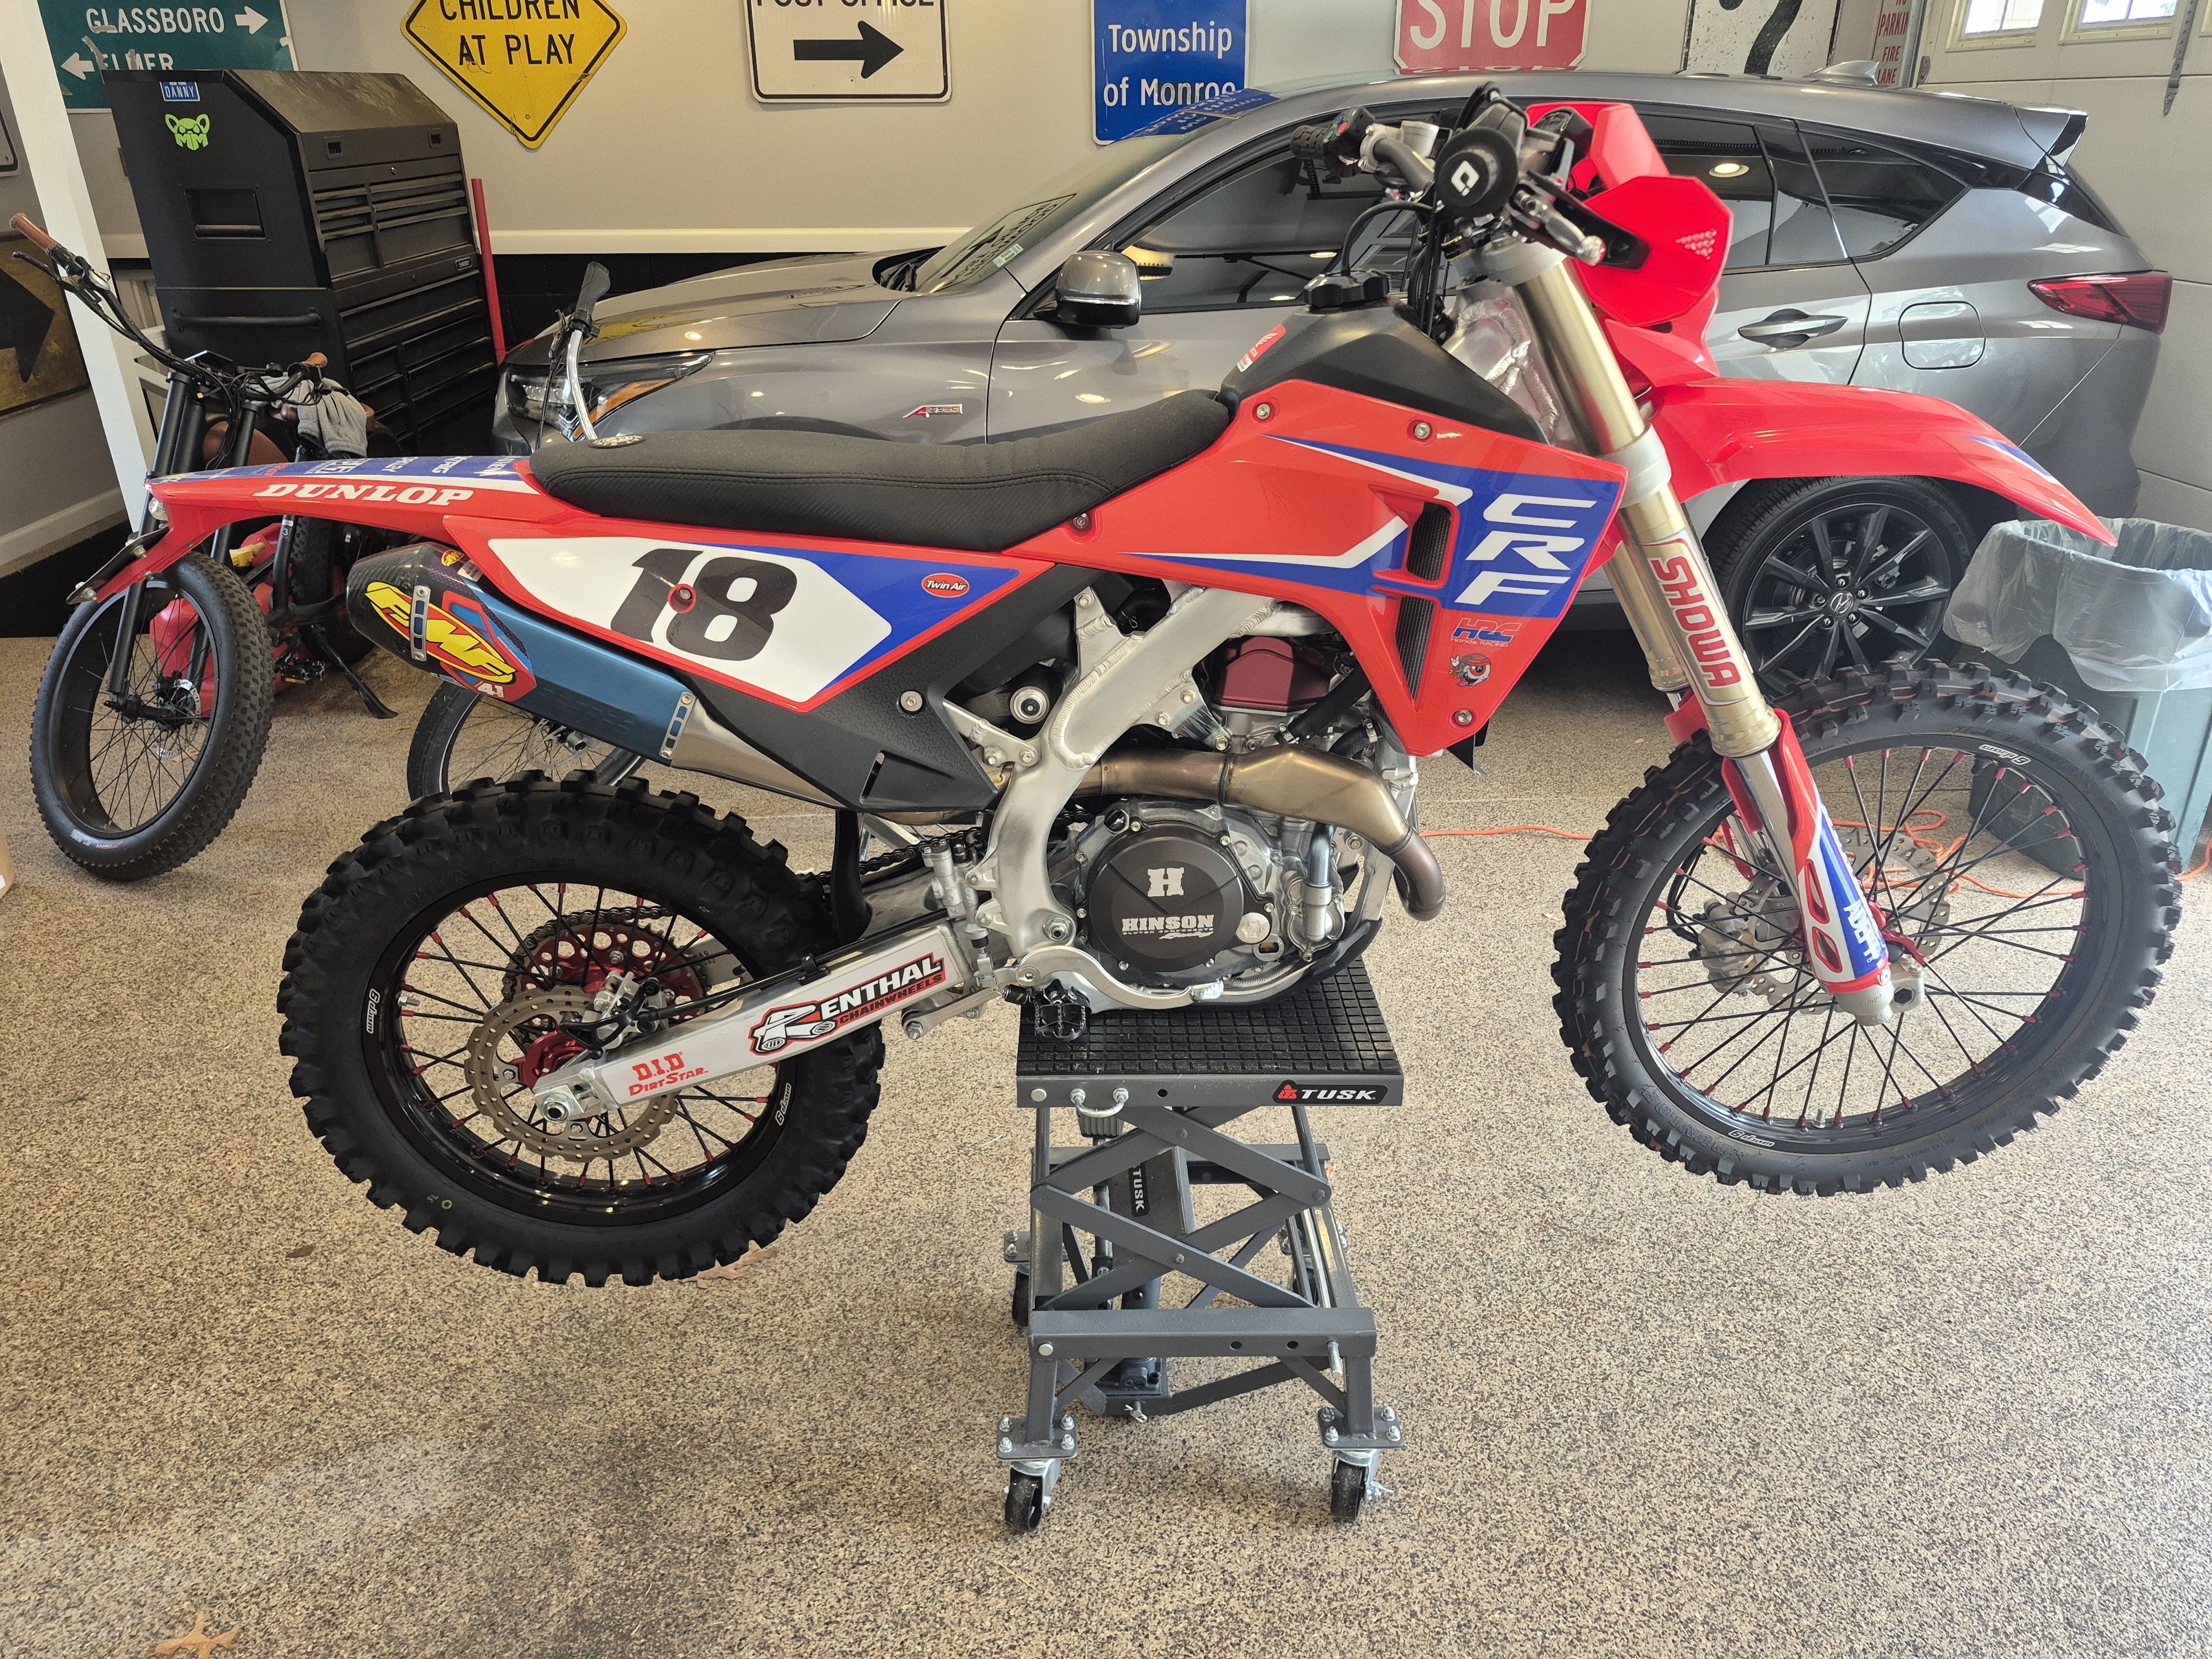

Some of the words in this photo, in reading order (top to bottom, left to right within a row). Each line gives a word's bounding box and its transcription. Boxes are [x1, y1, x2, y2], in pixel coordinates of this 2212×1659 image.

[86, 8, 225, 33] GLASSBORO
[442, 0, 580, 21] CHILDREN
[1879, 12, 1910, 36] PARKIN
[1410, 0, 1585, 50] STOP
[459, 35, 486, 66] AT
[507, 34, 575, 65] PLAY
[1108, 20, 1232, 59] Township
[1882, 46, 1901, 62] FIRE
[1877, 68, 1898, 84] LANE
[164, 86, 194, 98] DANNY
[1103, 76, 1129, 106] of
[252, 483, 474, 506] DUNLOP
[1453, 493, 1597, 606] CRF
[926, 579, 951, 589] Twin
[950, 582, 967, 591] Air
[611, 547, 798, 662] 18
[1452, 618, 1522, 643] HRC
[1651, 555, 1742, 688] SHOWA
[1147, 867, 1185, 897] H
[1121, 915, 1214, 932] HINSON
[753, 958, 942, 1052] RENTHAL
[840, 974, 943, 1023] CHAINWHEELS
[632, 1053, 685, 1081] D.I.D
[1301, 1089, 1377, 1100] TUSK
[1133, 1168, 1145, 1211] TUSK
